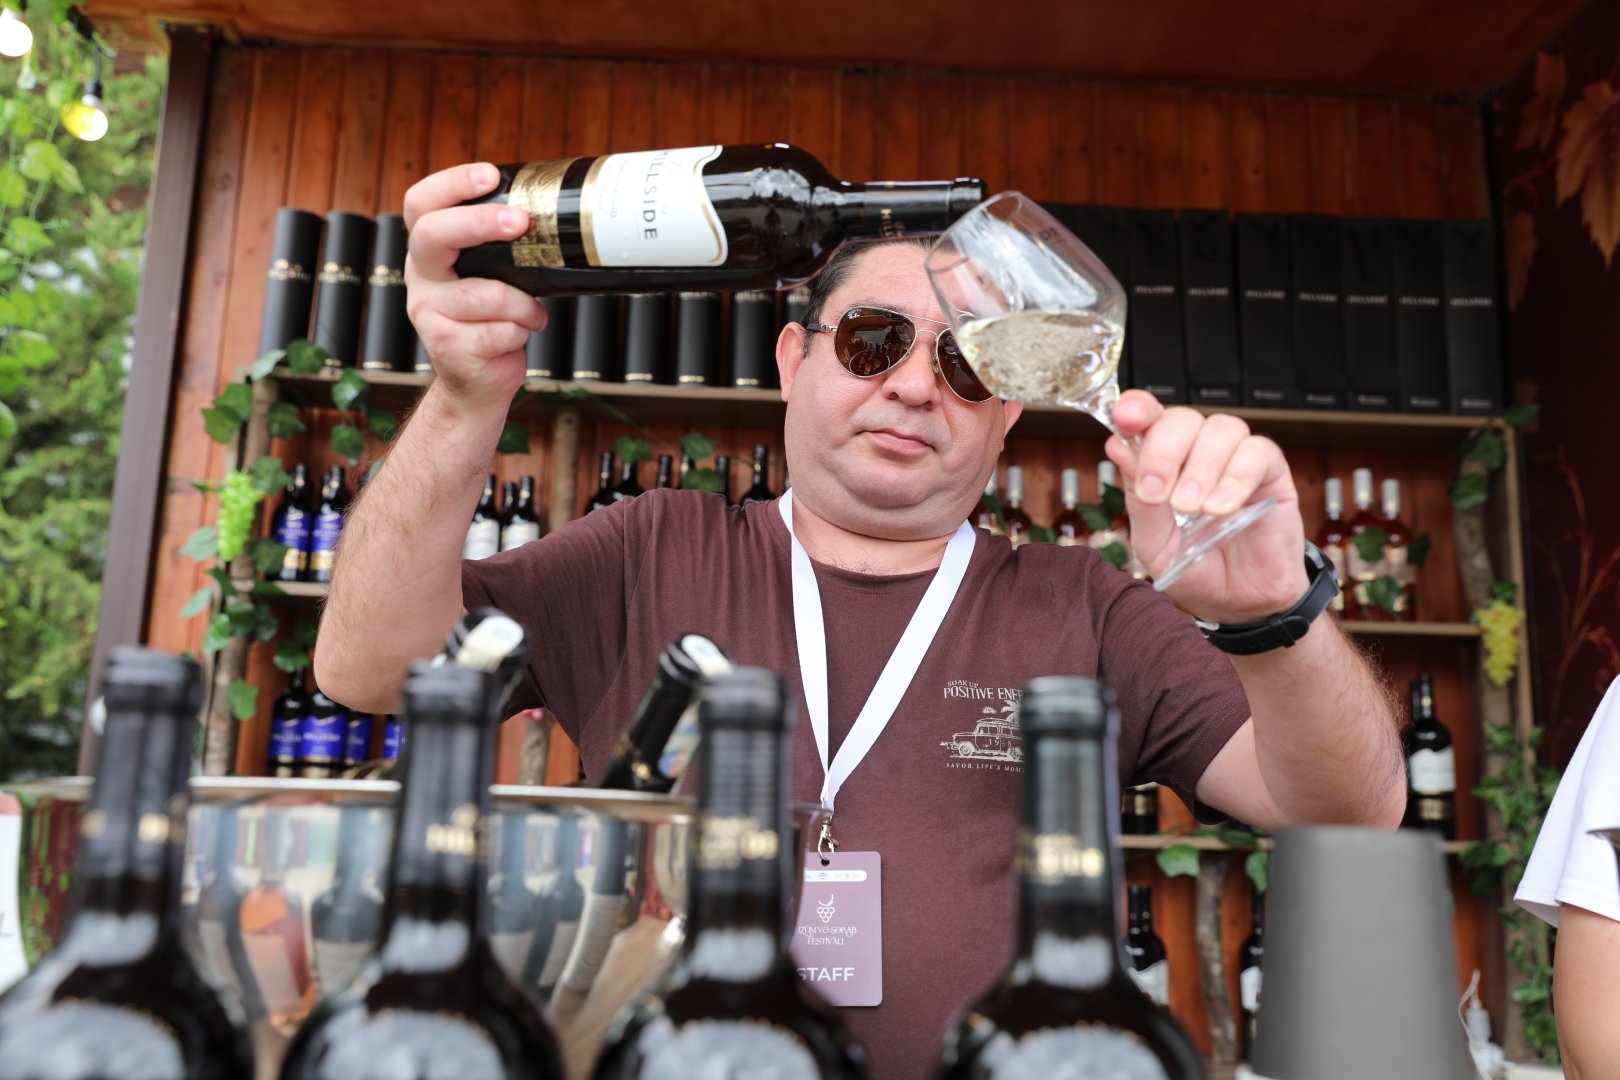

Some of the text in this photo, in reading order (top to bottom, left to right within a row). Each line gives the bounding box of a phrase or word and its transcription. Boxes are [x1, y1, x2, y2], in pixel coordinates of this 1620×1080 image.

[943, 686, 1024, 700] POSITIVE ENER
[796, 967, 855, 981] STAFF
